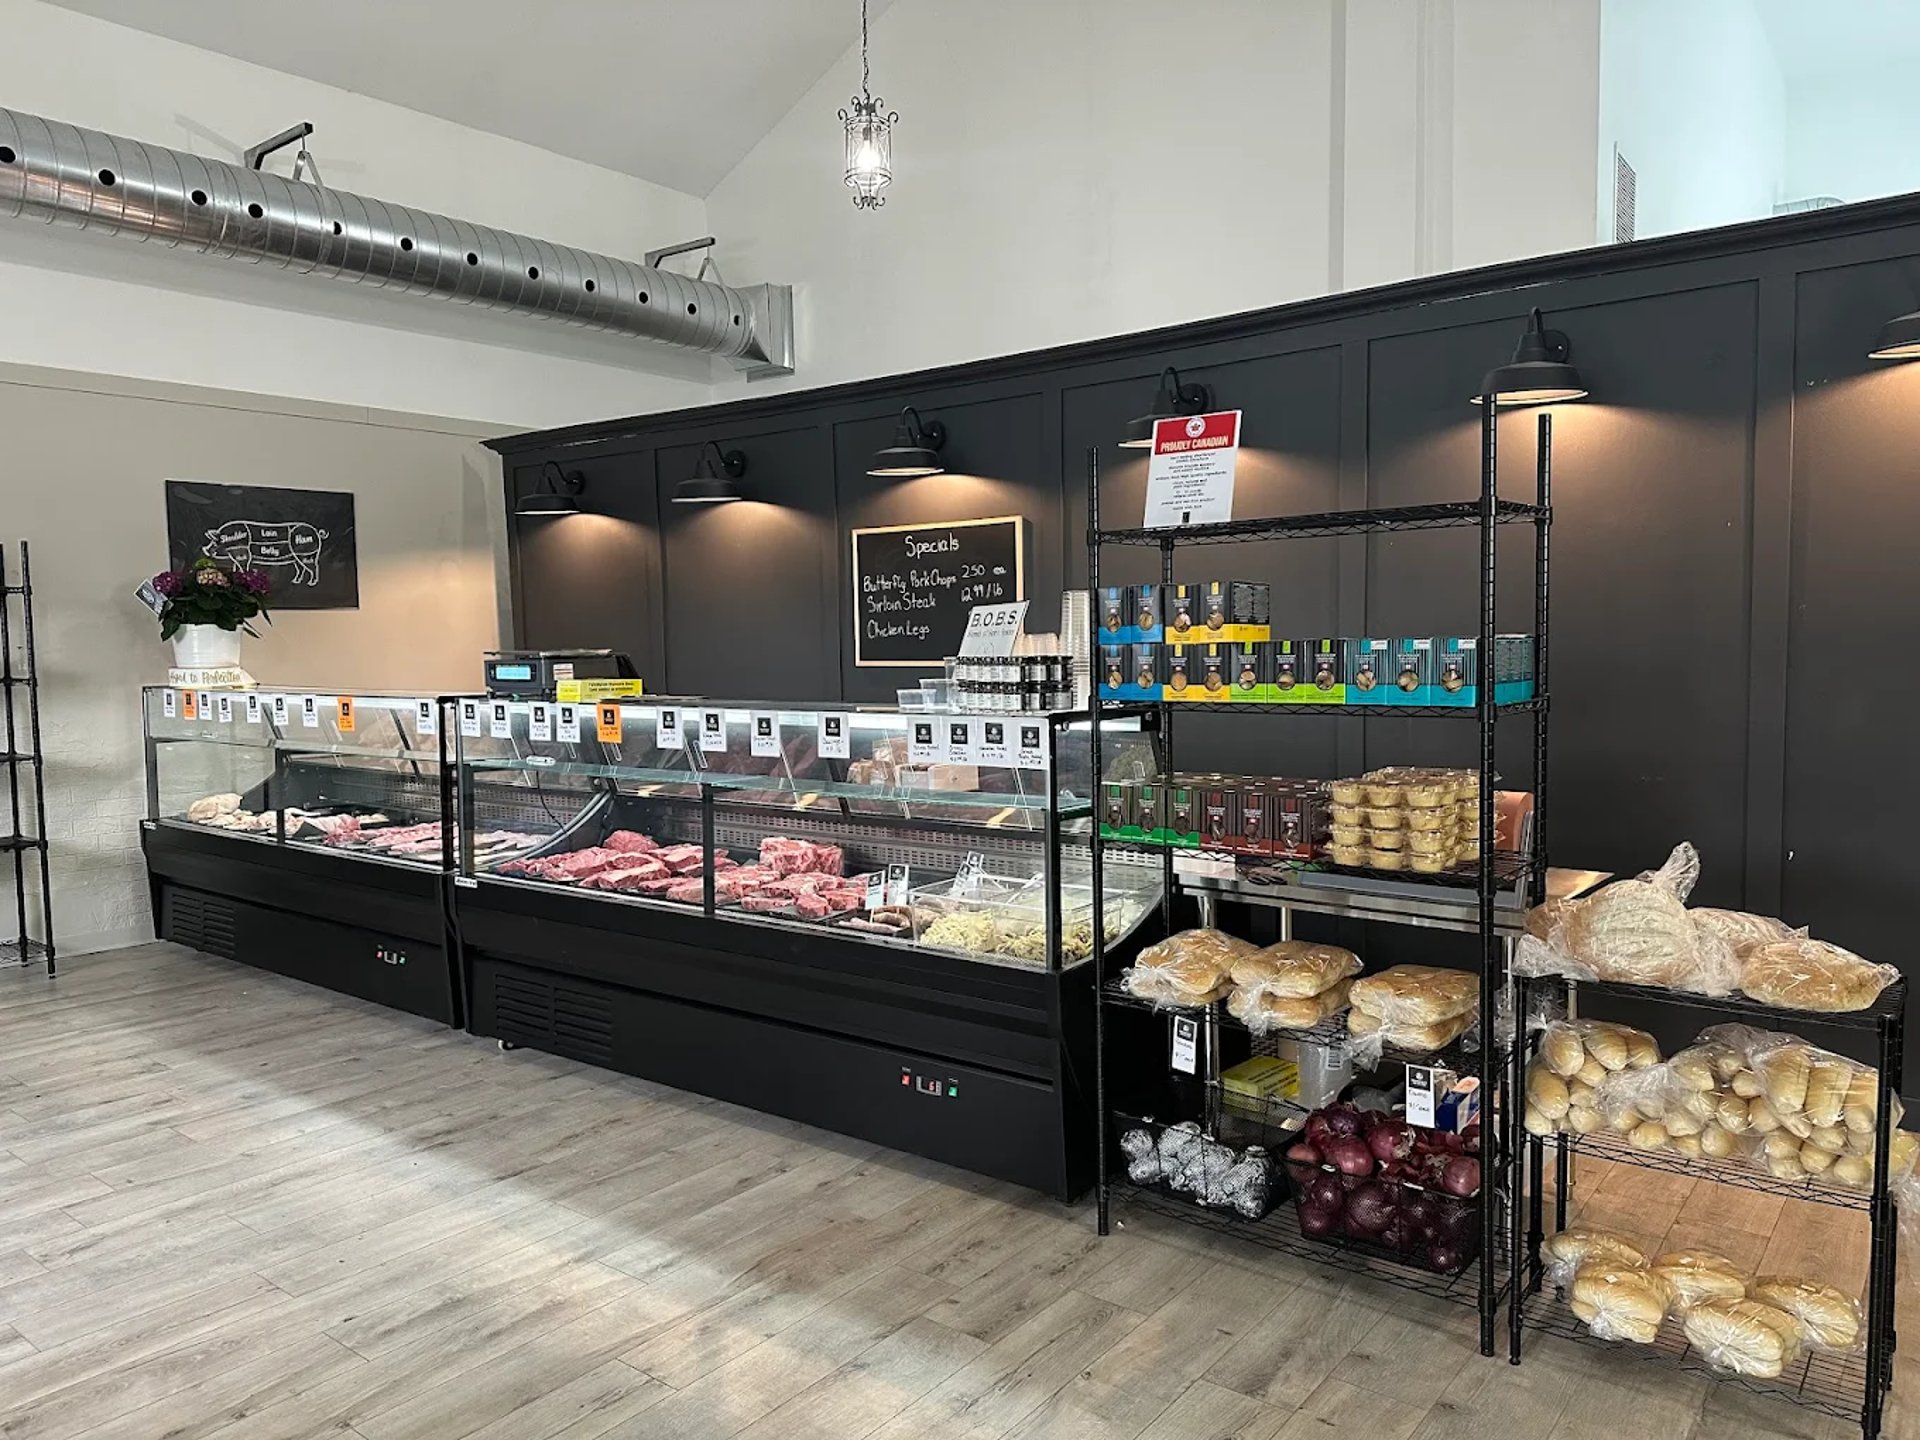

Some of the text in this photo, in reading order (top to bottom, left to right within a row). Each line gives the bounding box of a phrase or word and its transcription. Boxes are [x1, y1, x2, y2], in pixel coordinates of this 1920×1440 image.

[1161, 436, 1228, 452] PROUDLY CANADIAN
[220, 531, 247, 543] Shoulder
[295, 535, 313, 544] Ham
[260, 546, 279, 557] Belly
[905, 532, 960, 559] Specials
[863, 573, 907, 594] Butterfly
[971, 610, 1017, 627] B.O.B.S.
